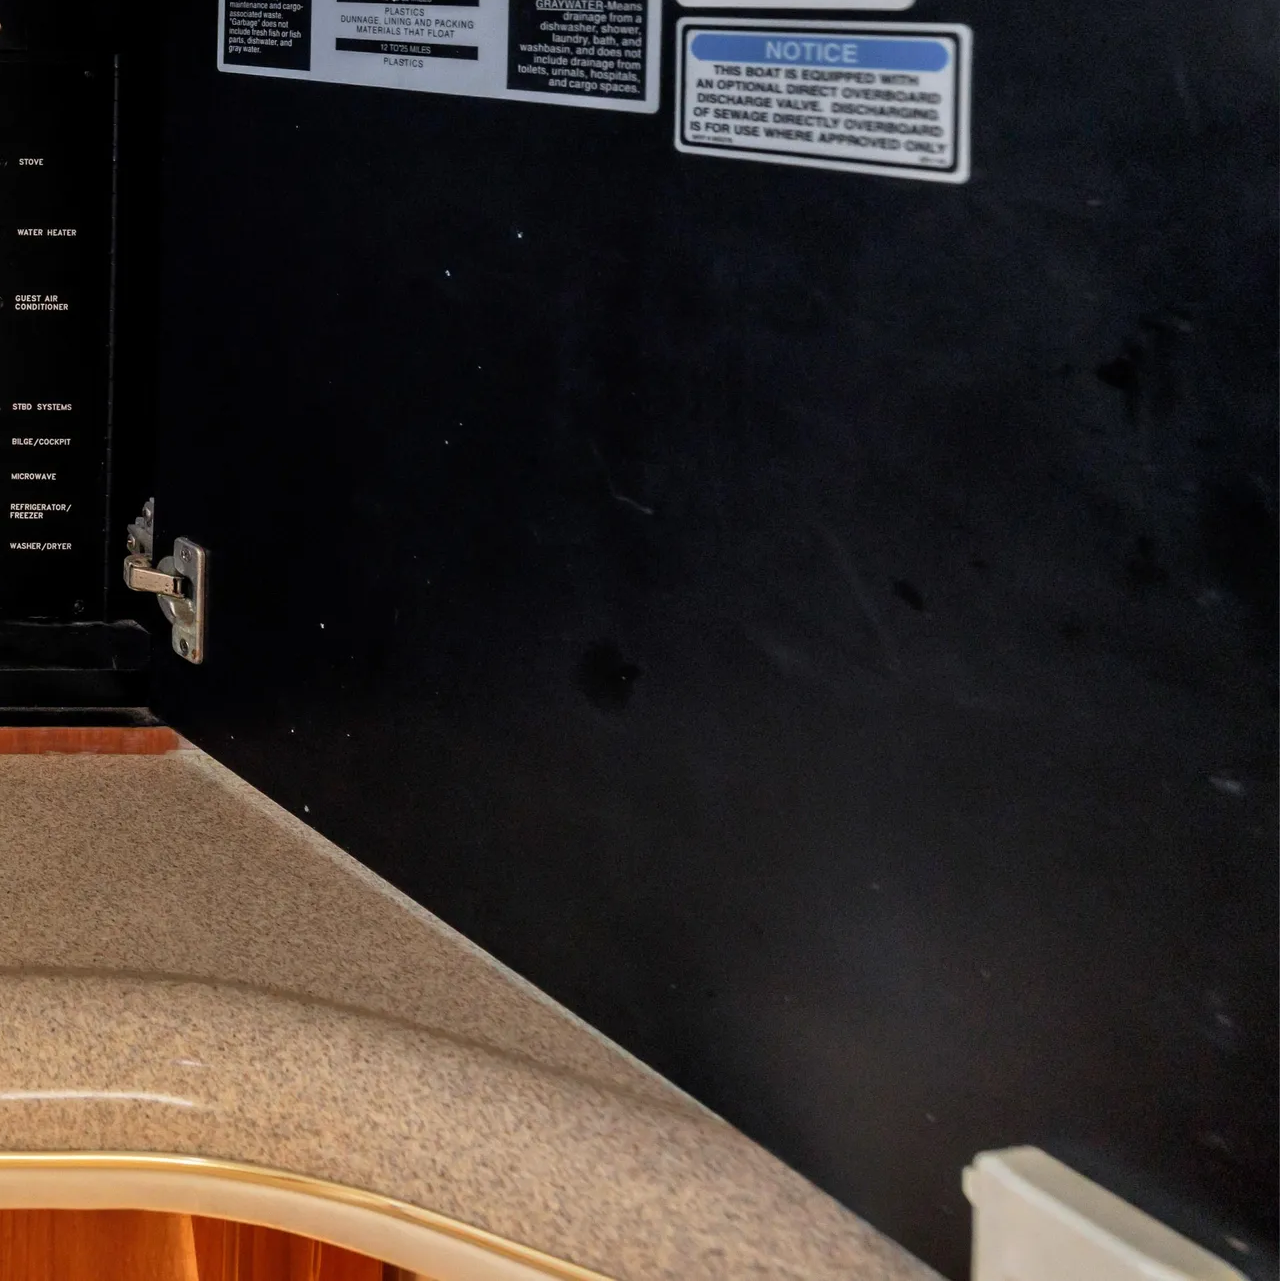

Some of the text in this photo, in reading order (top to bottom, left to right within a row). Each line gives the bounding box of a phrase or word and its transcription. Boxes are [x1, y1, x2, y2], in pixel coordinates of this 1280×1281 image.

[765, 40, 858, 64] NOTICE
[713, 64, 919, 86] THIS BOAT IS EQUIPPED WITH
[696, 79, 942, 104] AN OPTIONAL DIRECT OVERBOARD
[18, 158, 44, 166] STOVE
[17, 228, 77, 237] WATER HEATER
[14, 294, 58, 303] GUEST AIR
[14, 302, 69, 311] CONDITIONER
[11, 472, 57, 481] MICROWAVE
[9, 542, 72, 551] WASHER/DRYER
